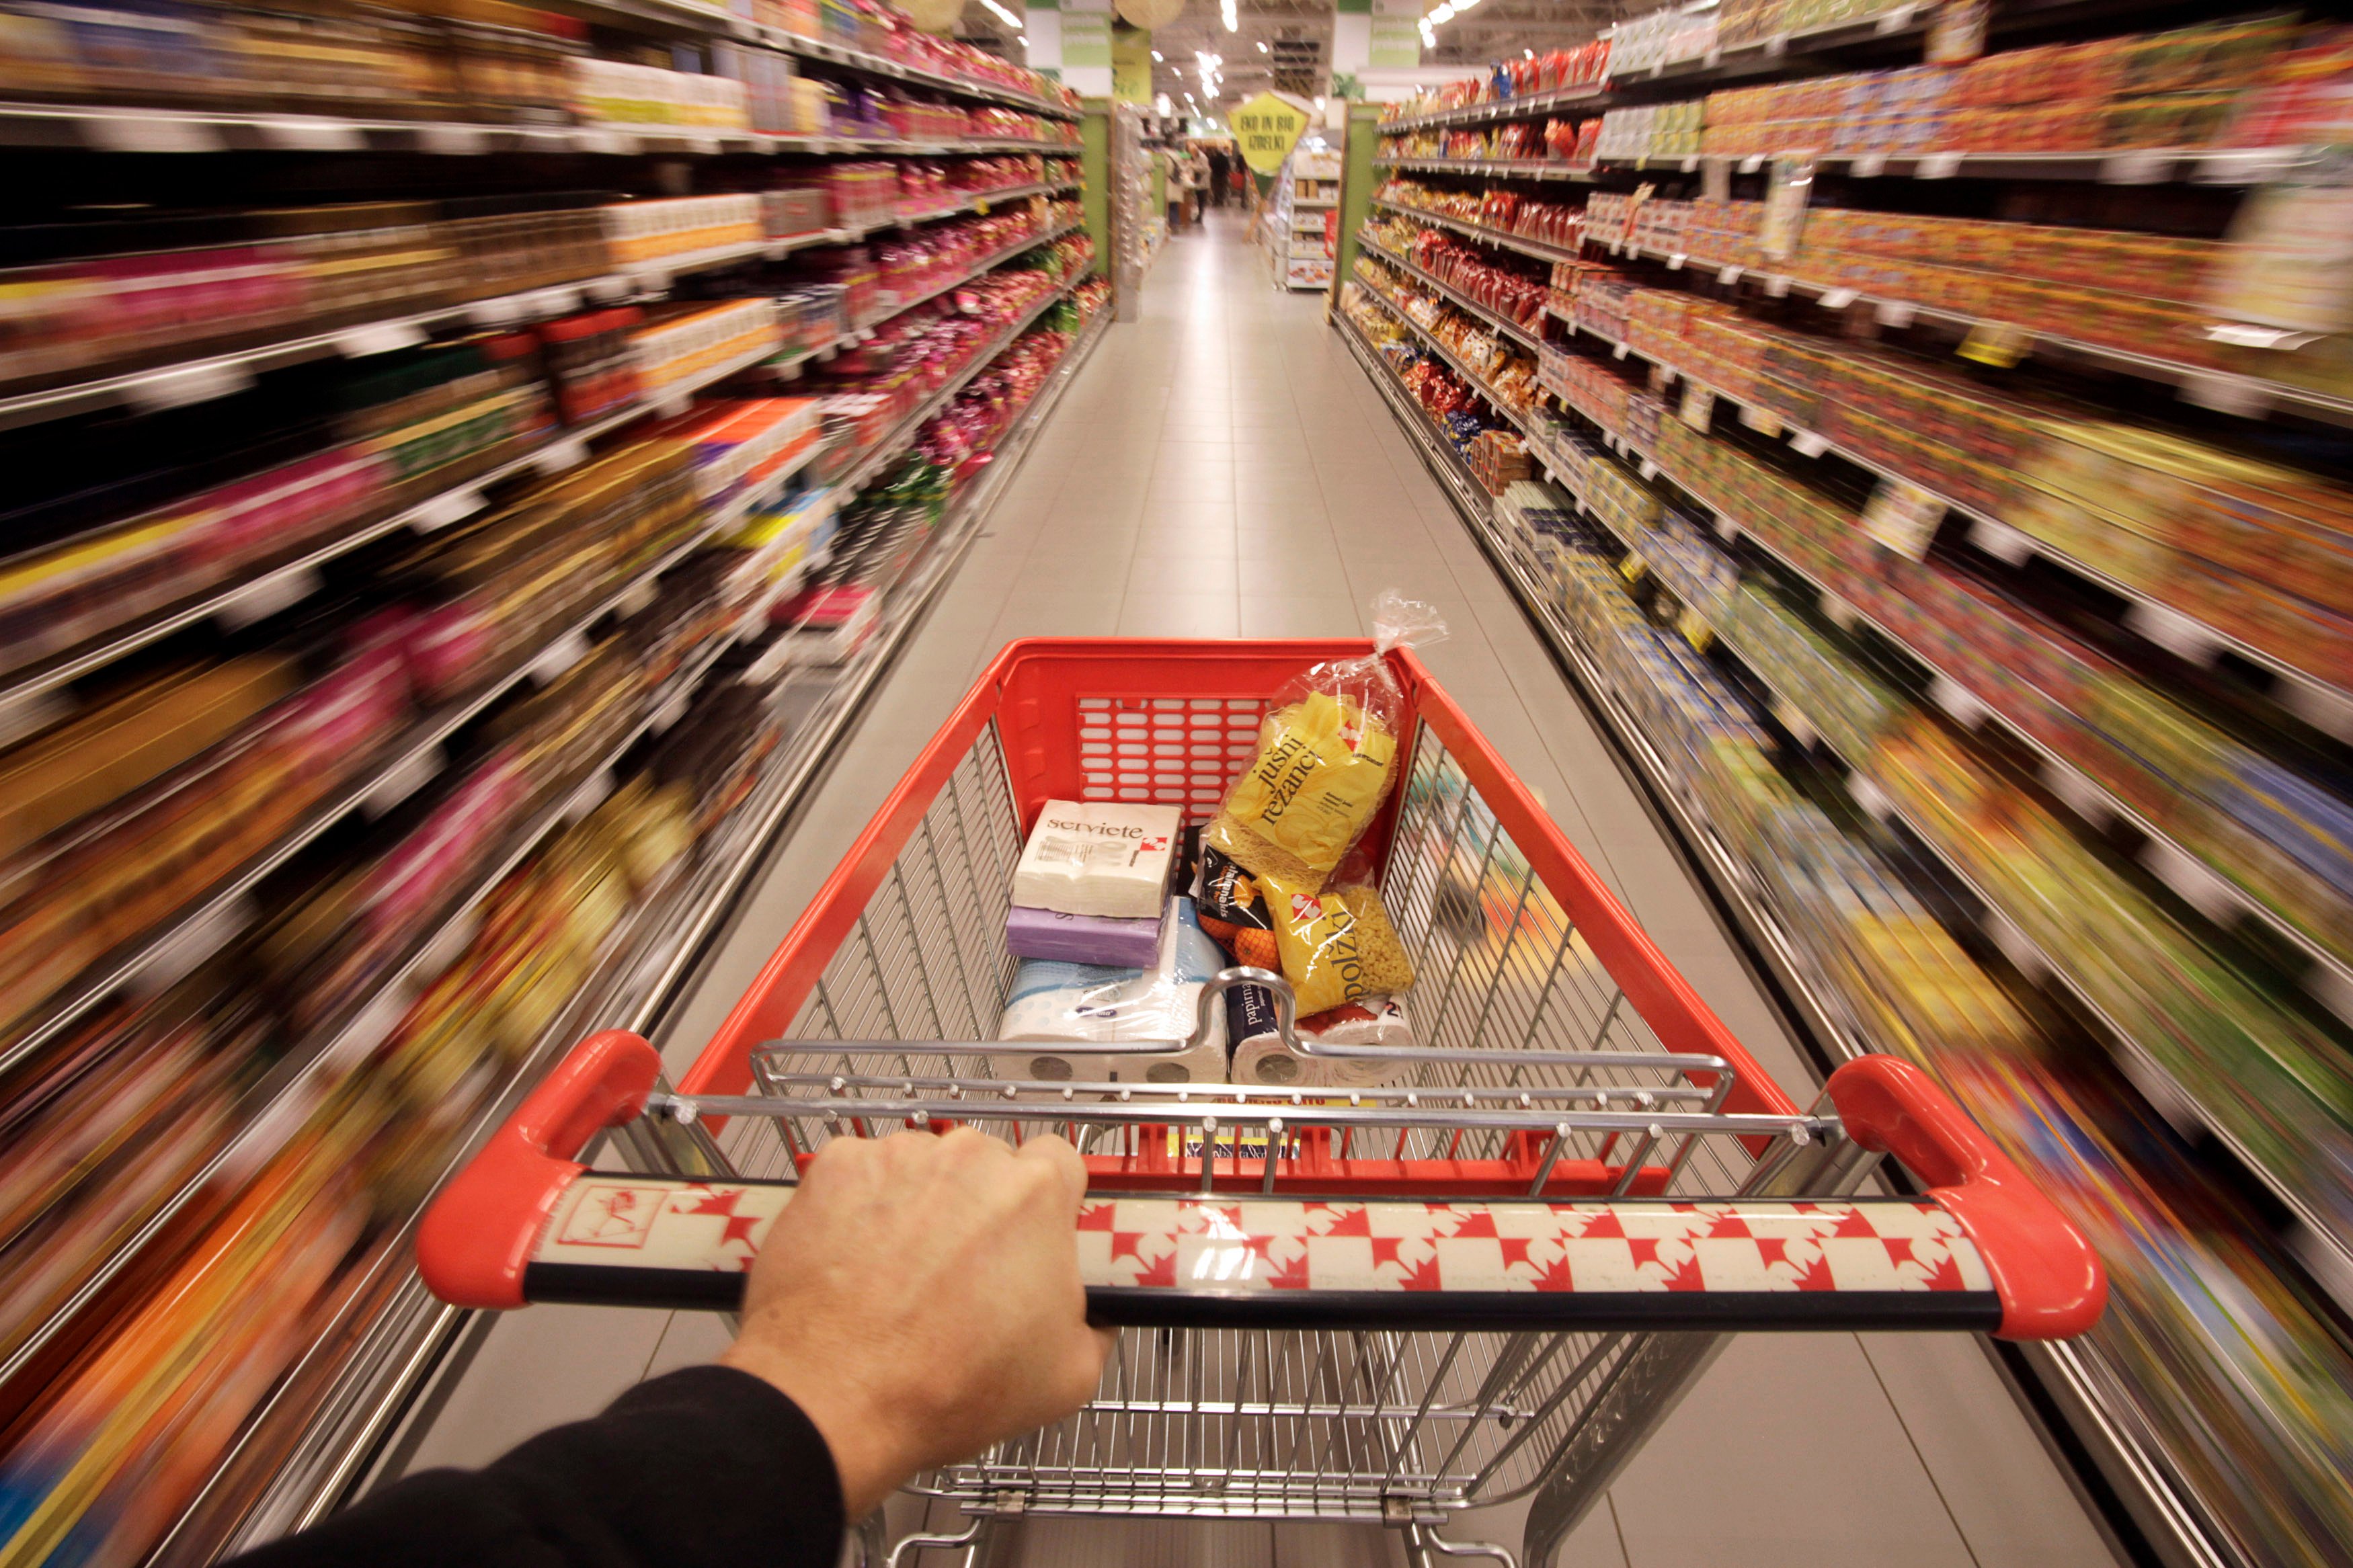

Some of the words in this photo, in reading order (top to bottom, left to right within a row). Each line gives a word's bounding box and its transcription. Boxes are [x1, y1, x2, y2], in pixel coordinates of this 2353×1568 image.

[1240, 115, 1258, 132] EKO
[1262, 115, 1272, 131] IN
[1277, 115, 1294, 132] BIO
[1248, 135, 1285, 151] IZDELKI
[1252, 734, 1305, 794] jušni
[1260, 745, 1324, 827] rezanci
[1047, 818, 1143, 839] serviete
[1322, 910, 1371, 1001] polžki
